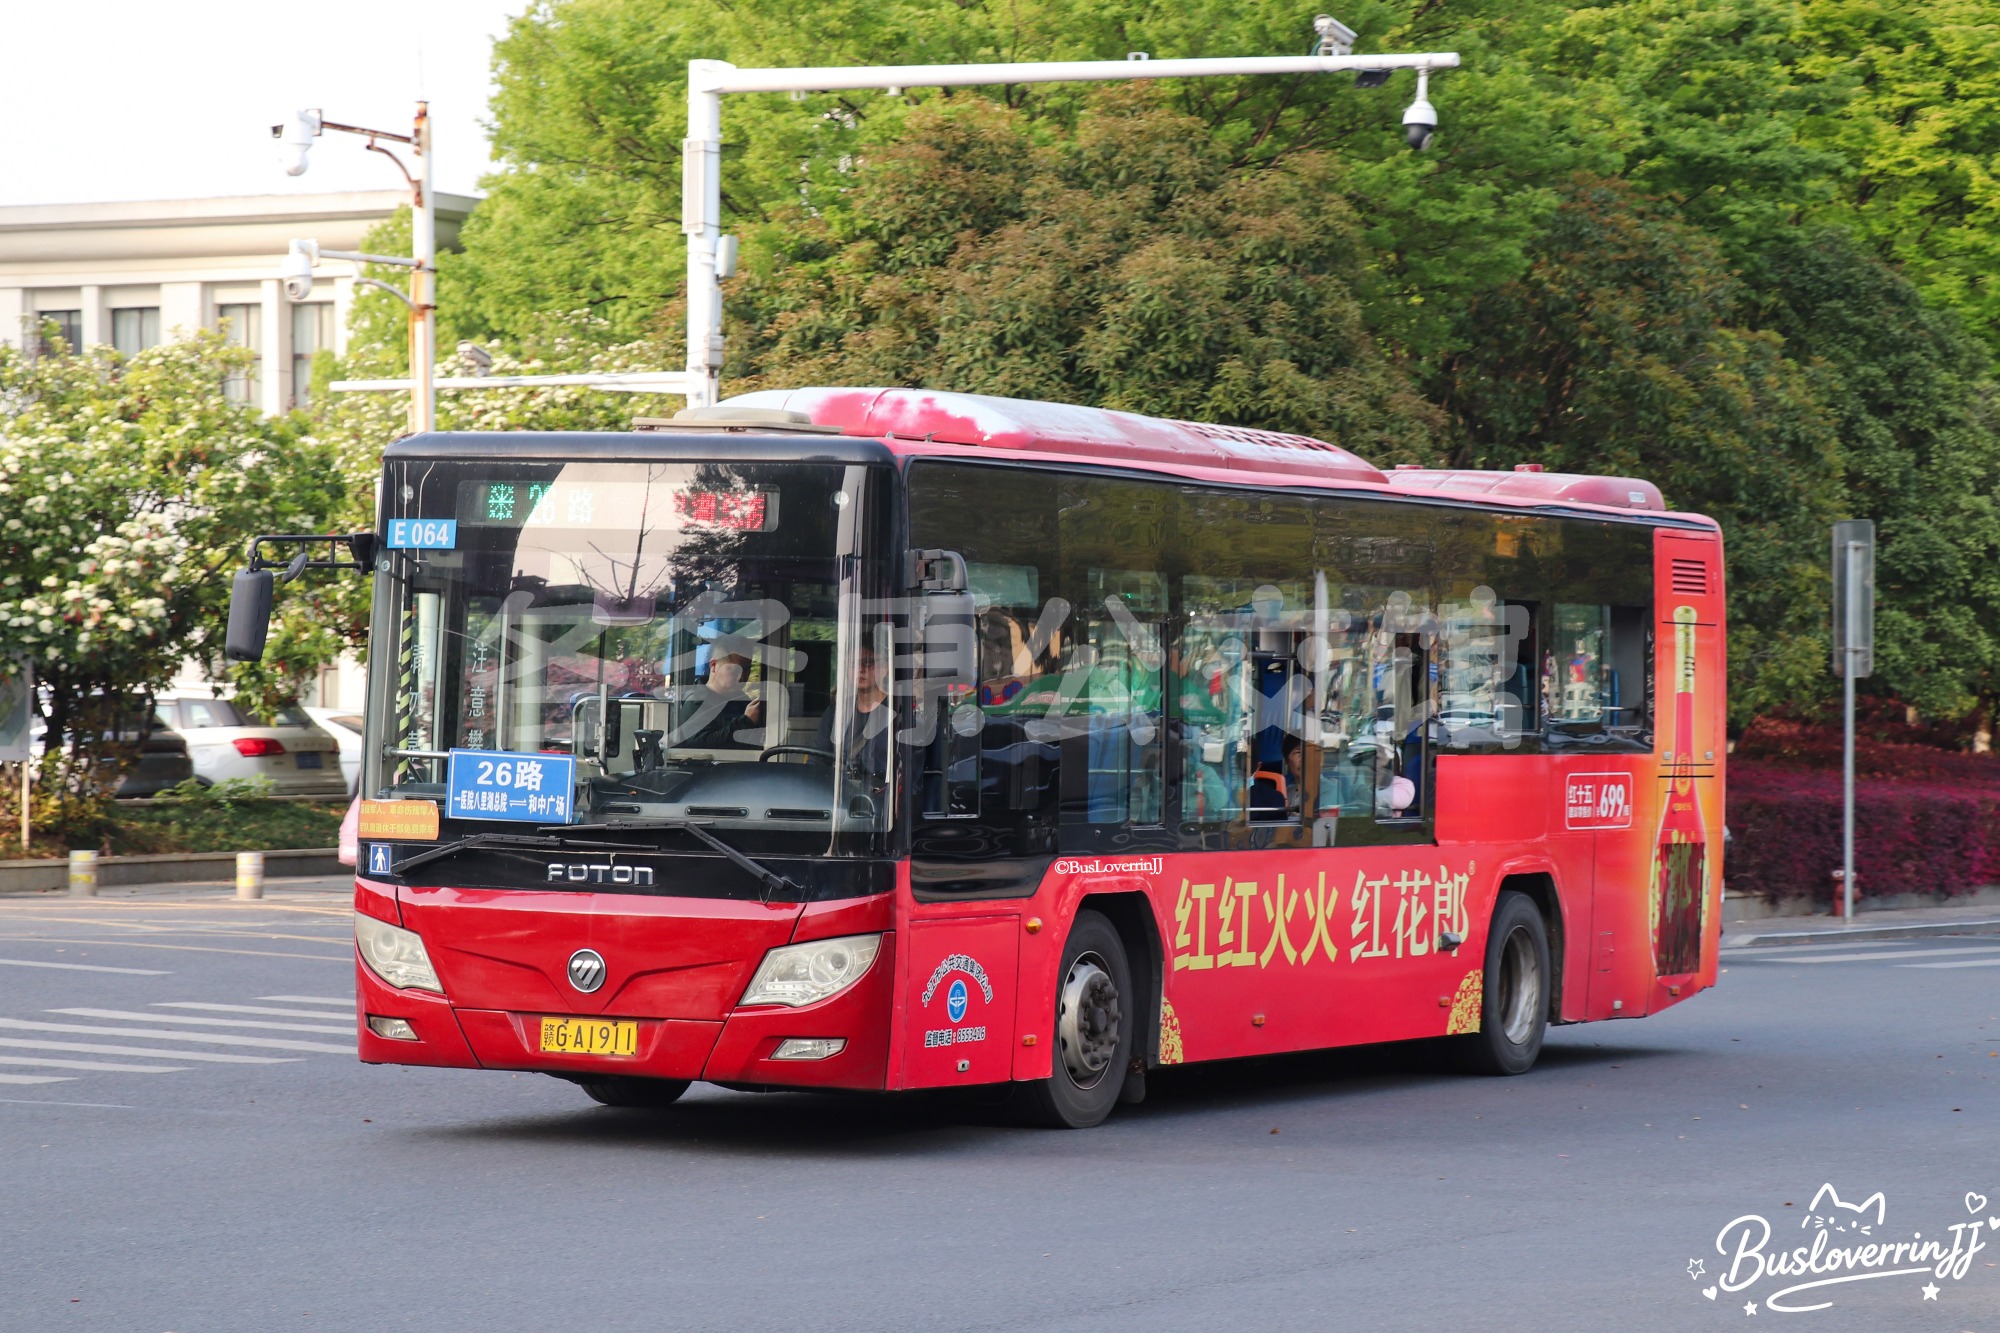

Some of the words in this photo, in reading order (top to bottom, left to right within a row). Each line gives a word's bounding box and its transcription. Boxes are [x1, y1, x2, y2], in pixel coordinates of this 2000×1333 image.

[394, 521, 406, 545] E
[411, 522, 449, 546] 064
[476, 760, 544, 791] 26路
[453, 789, 508, 813] 一医院八里湖总院
[528, 794, 565, 817] 和中广场
[547, 863, 654, 885] FOTON
[1173, 871, 1339, 972] 红红火火
[1349, 864, 1470, 964] 红花郎
